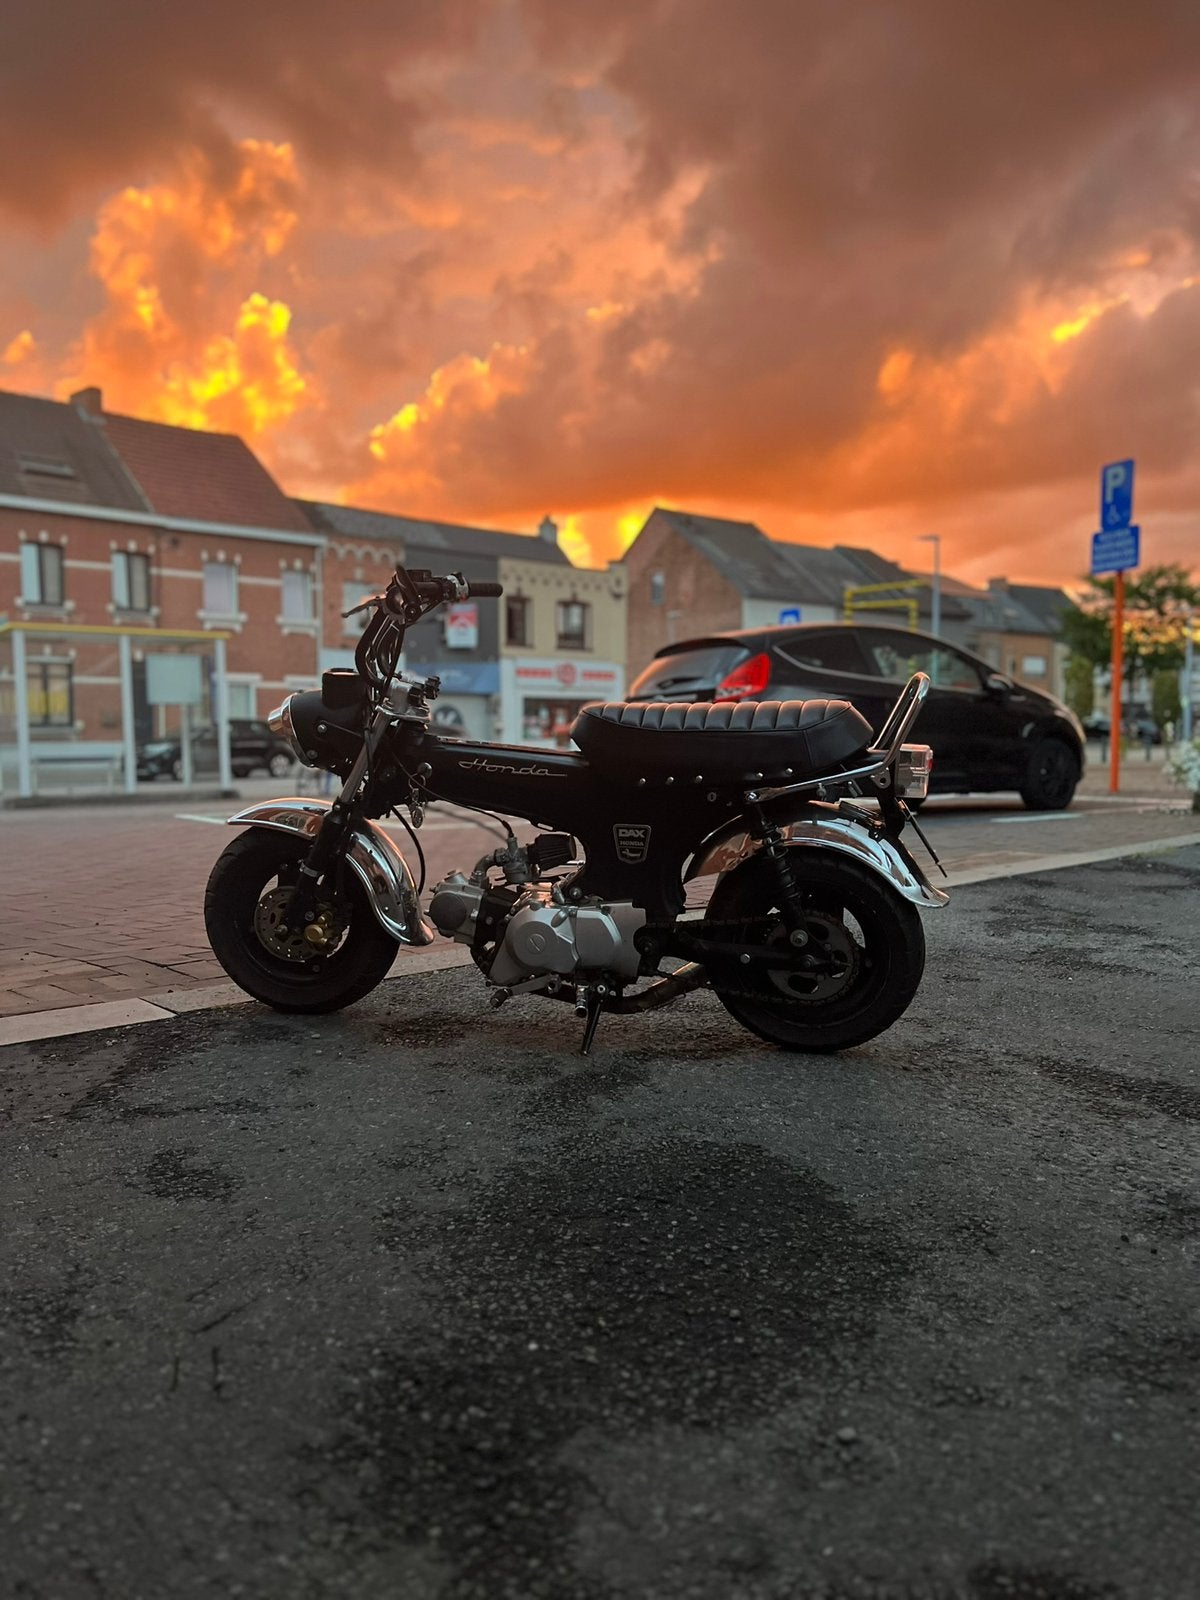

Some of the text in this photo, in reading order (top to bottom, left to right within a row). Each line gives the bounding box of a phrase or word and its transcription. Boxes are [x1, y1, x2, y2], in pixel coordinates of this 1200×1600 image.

[1105, 465, 1125, 503] P
[458, 758, 567, 776] Honda
[618, 829, 645, 838] DAX
